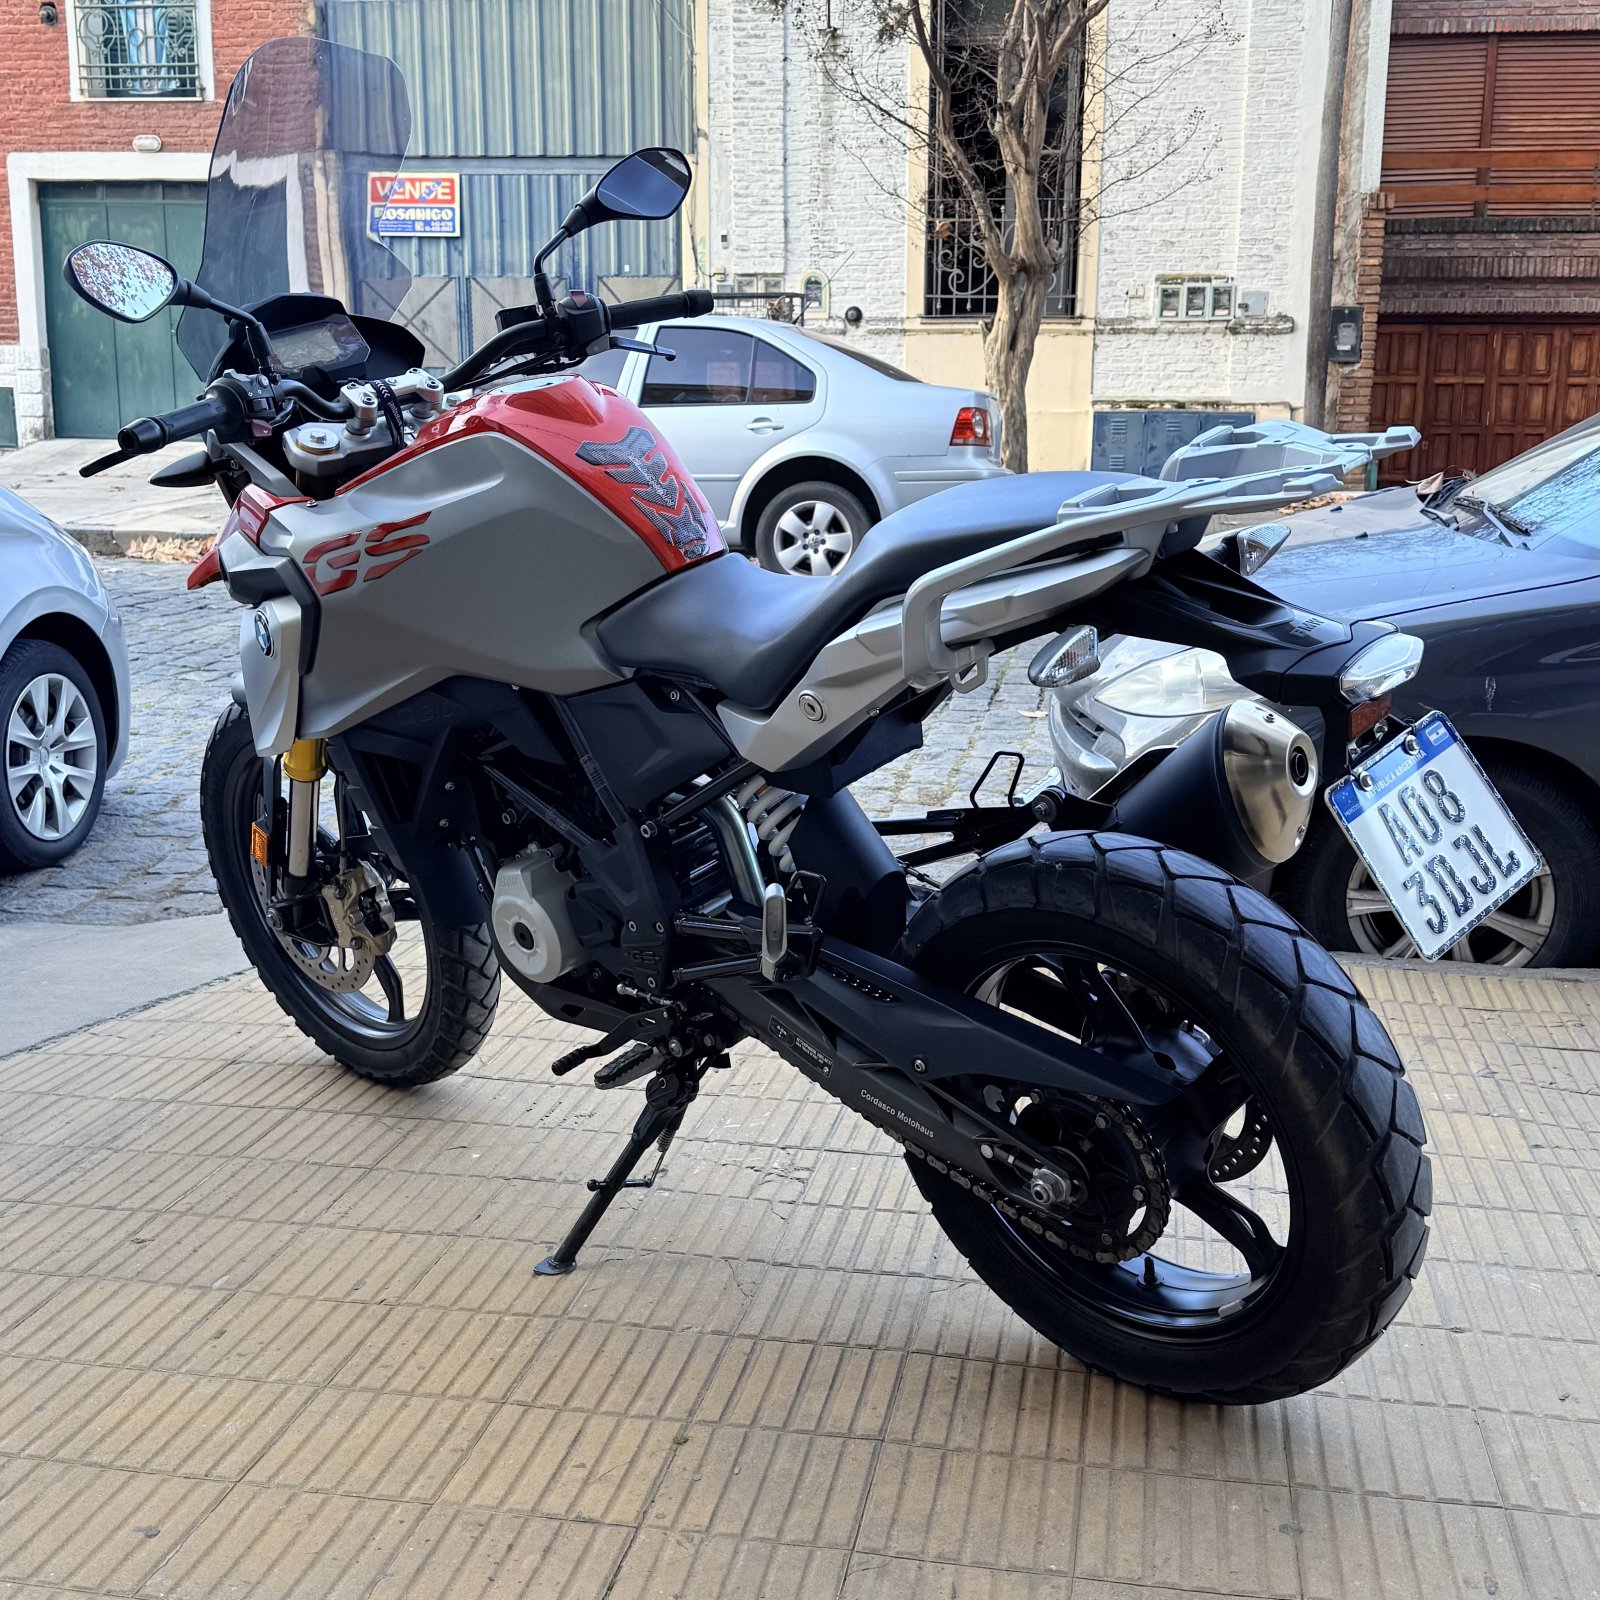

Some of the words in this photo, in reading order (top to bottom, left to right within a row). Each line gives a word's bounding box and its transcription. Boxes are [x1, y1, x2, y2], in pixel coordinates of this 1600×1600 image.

[375, 180, 452, 200] VENDE
[302, 511, 432, 597] GS
[1395, 750, 1428, 780] ARGENTINA
[1377, 769, 1467, 867] A08
[860, 1089, 896, 1116] Cordasco
[896, 1110, 935, 1138] Motohaus
